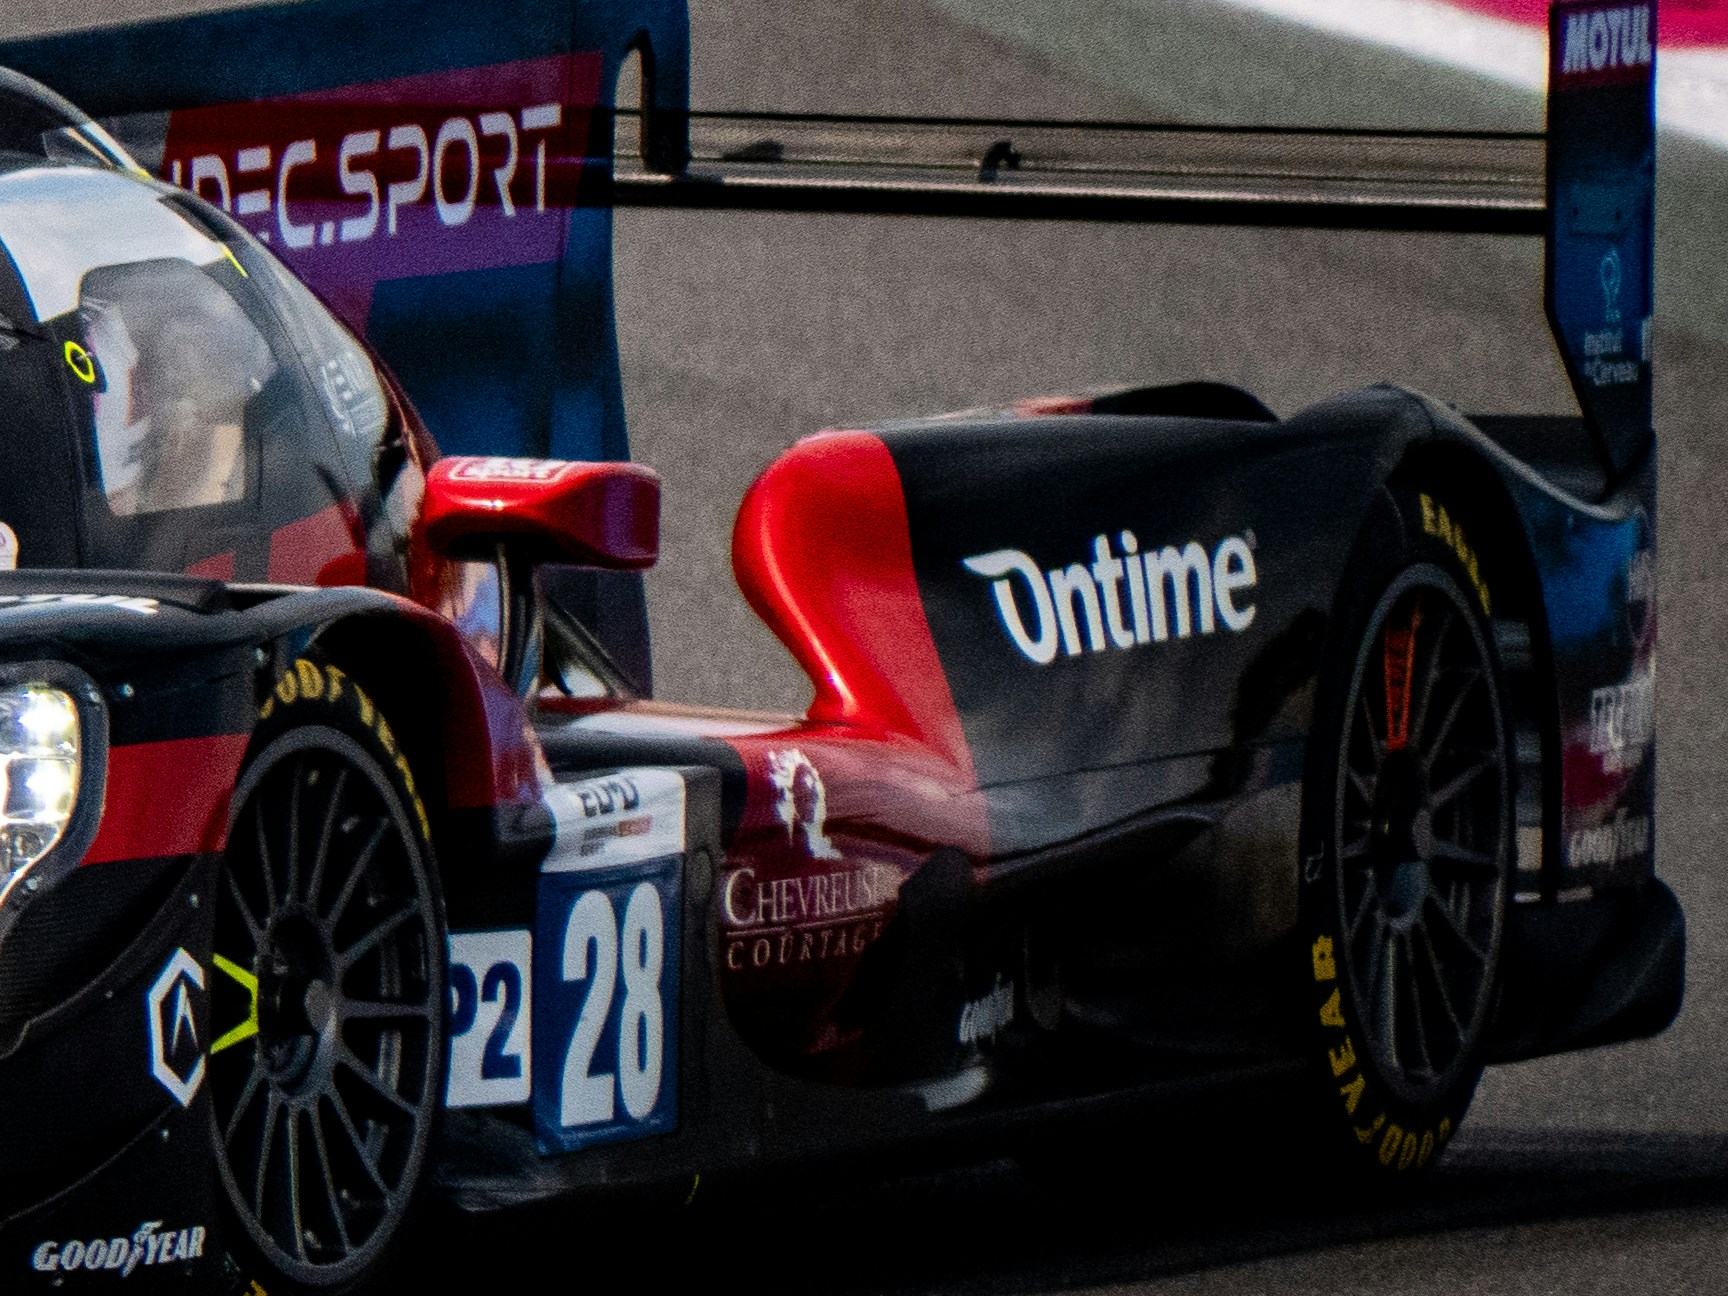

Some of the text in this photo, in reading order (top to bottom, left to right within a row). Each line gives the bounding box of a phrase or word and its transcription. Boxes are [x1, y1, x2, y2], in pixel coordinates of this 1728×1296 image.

[1562, 5, 1652, 73] MOTUL
[171, 104, 562, 248] DEC.SPORT
[961, 529, 1258, 665] Ontime
[448, 960, 523, 1080] P2
[560, 882, 665, 1128] 28
[32, 1219, 206, 1278] GOODYEAR
